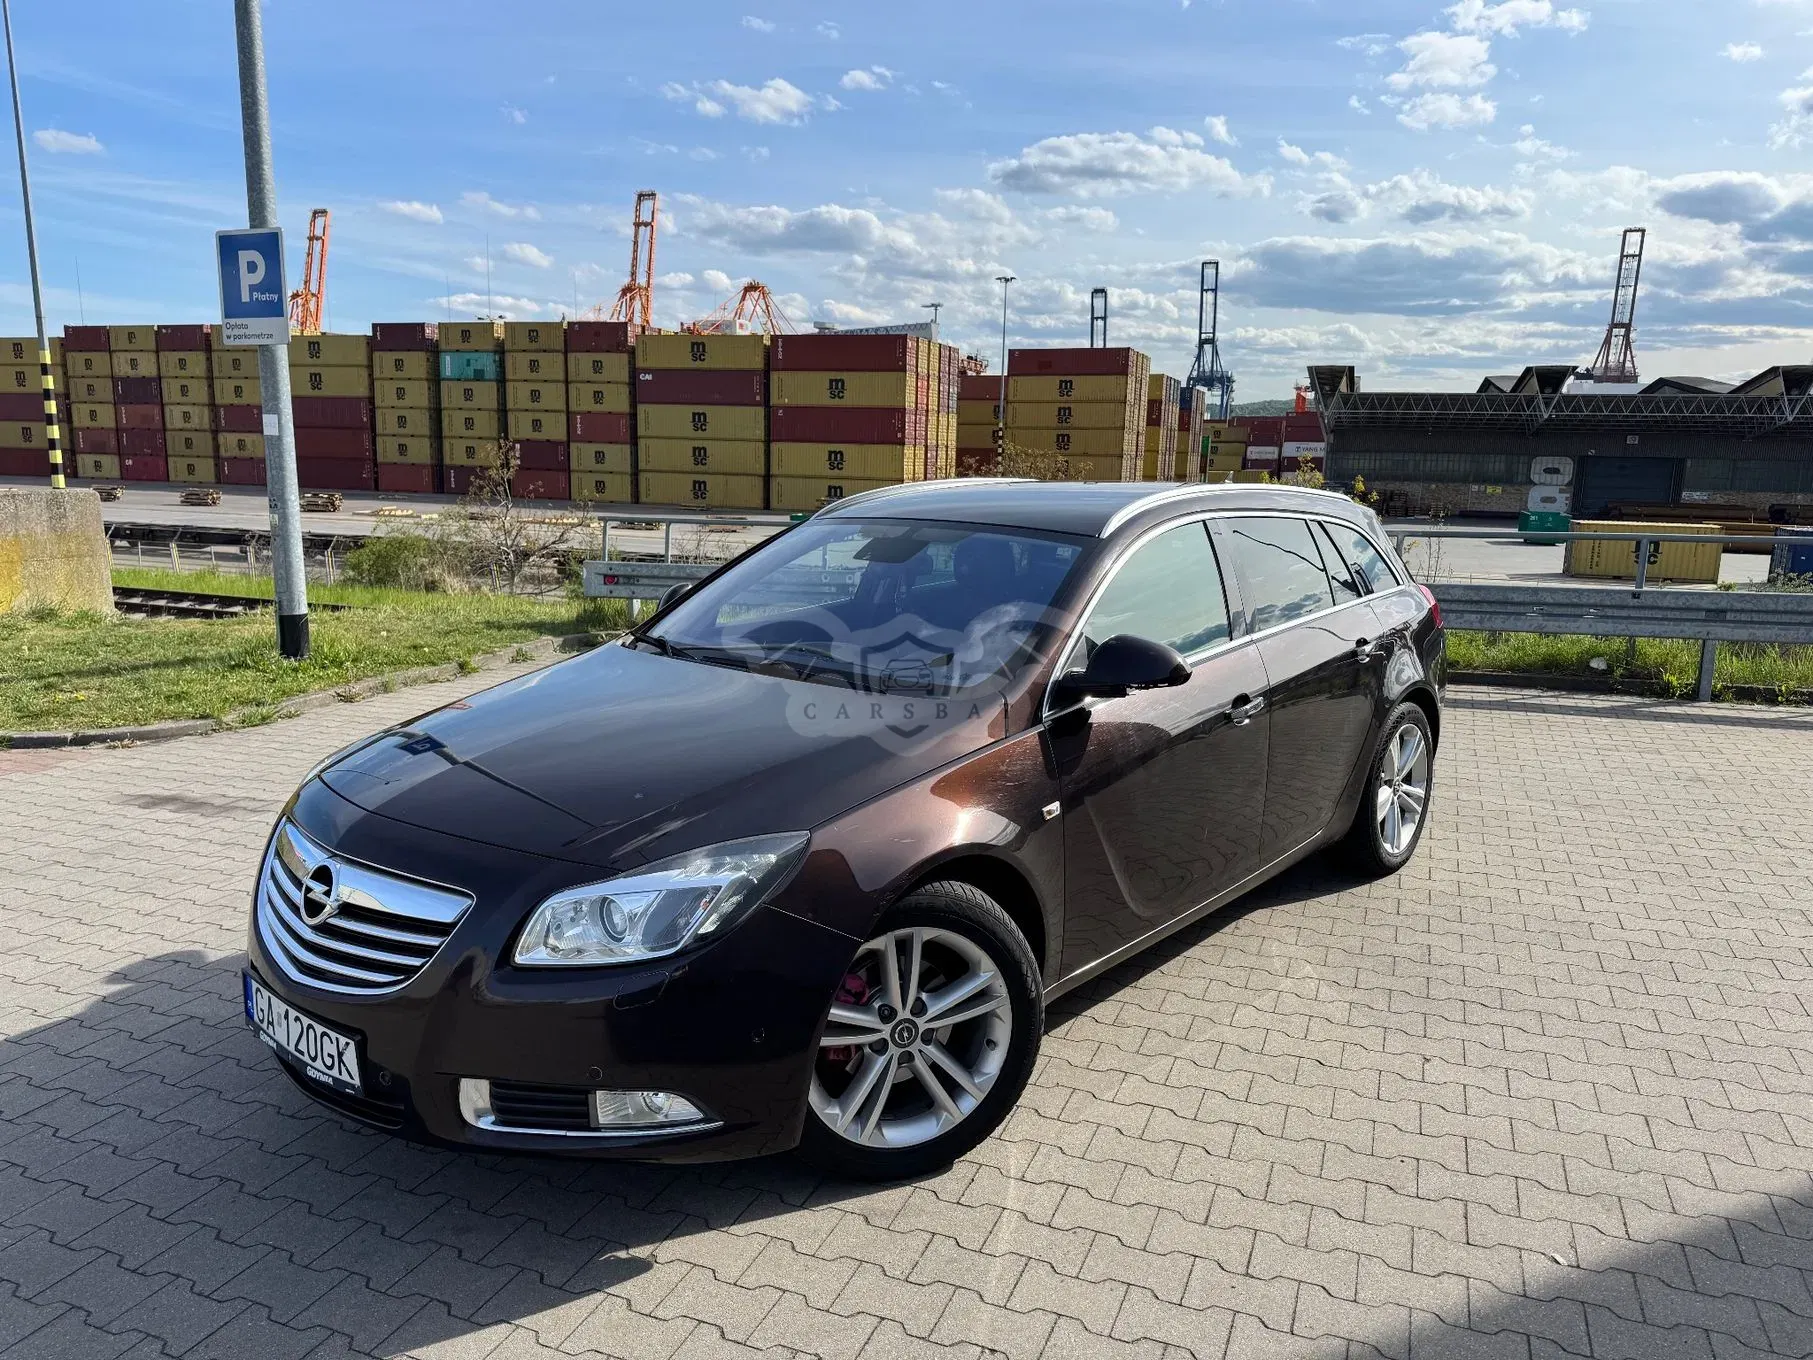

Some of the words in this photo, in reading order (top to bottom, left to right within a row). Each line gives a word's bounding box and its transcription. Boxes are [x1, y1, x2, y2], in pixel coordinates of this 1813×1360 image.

[238, 250, 266, 303] P
[252, 291, 279, 303] Płatny
[225, 322, 249, 331] Opłata
[233, 332, 274, 341] parkometrze
[255, 986, 276, 1036] GA
[283, 1008, 355, 1081] 120GK
